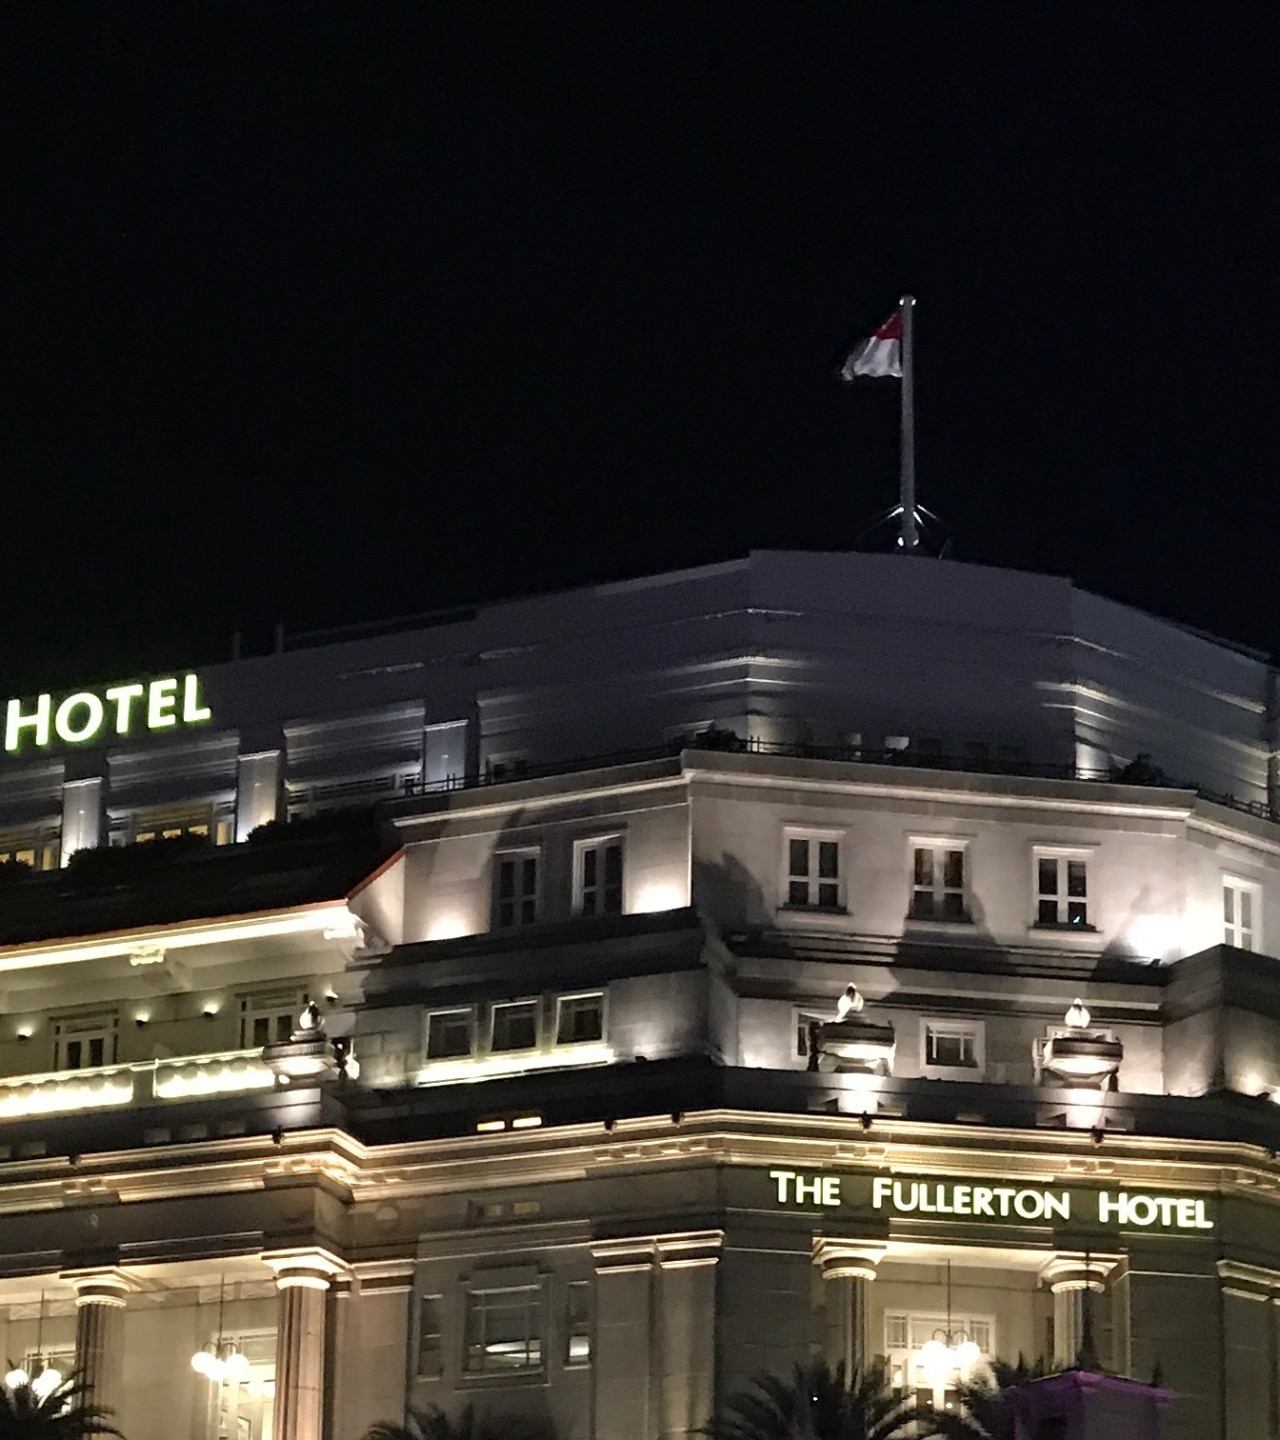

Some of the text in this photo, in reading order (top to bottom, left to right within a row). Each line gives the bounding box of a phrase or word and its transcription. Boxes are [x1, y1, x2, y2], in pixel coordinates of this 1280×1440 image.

[5, 674, 211, 751] HOTEL
[770, 1171, 1214, 1229] THE FULLERTON HOTEL
